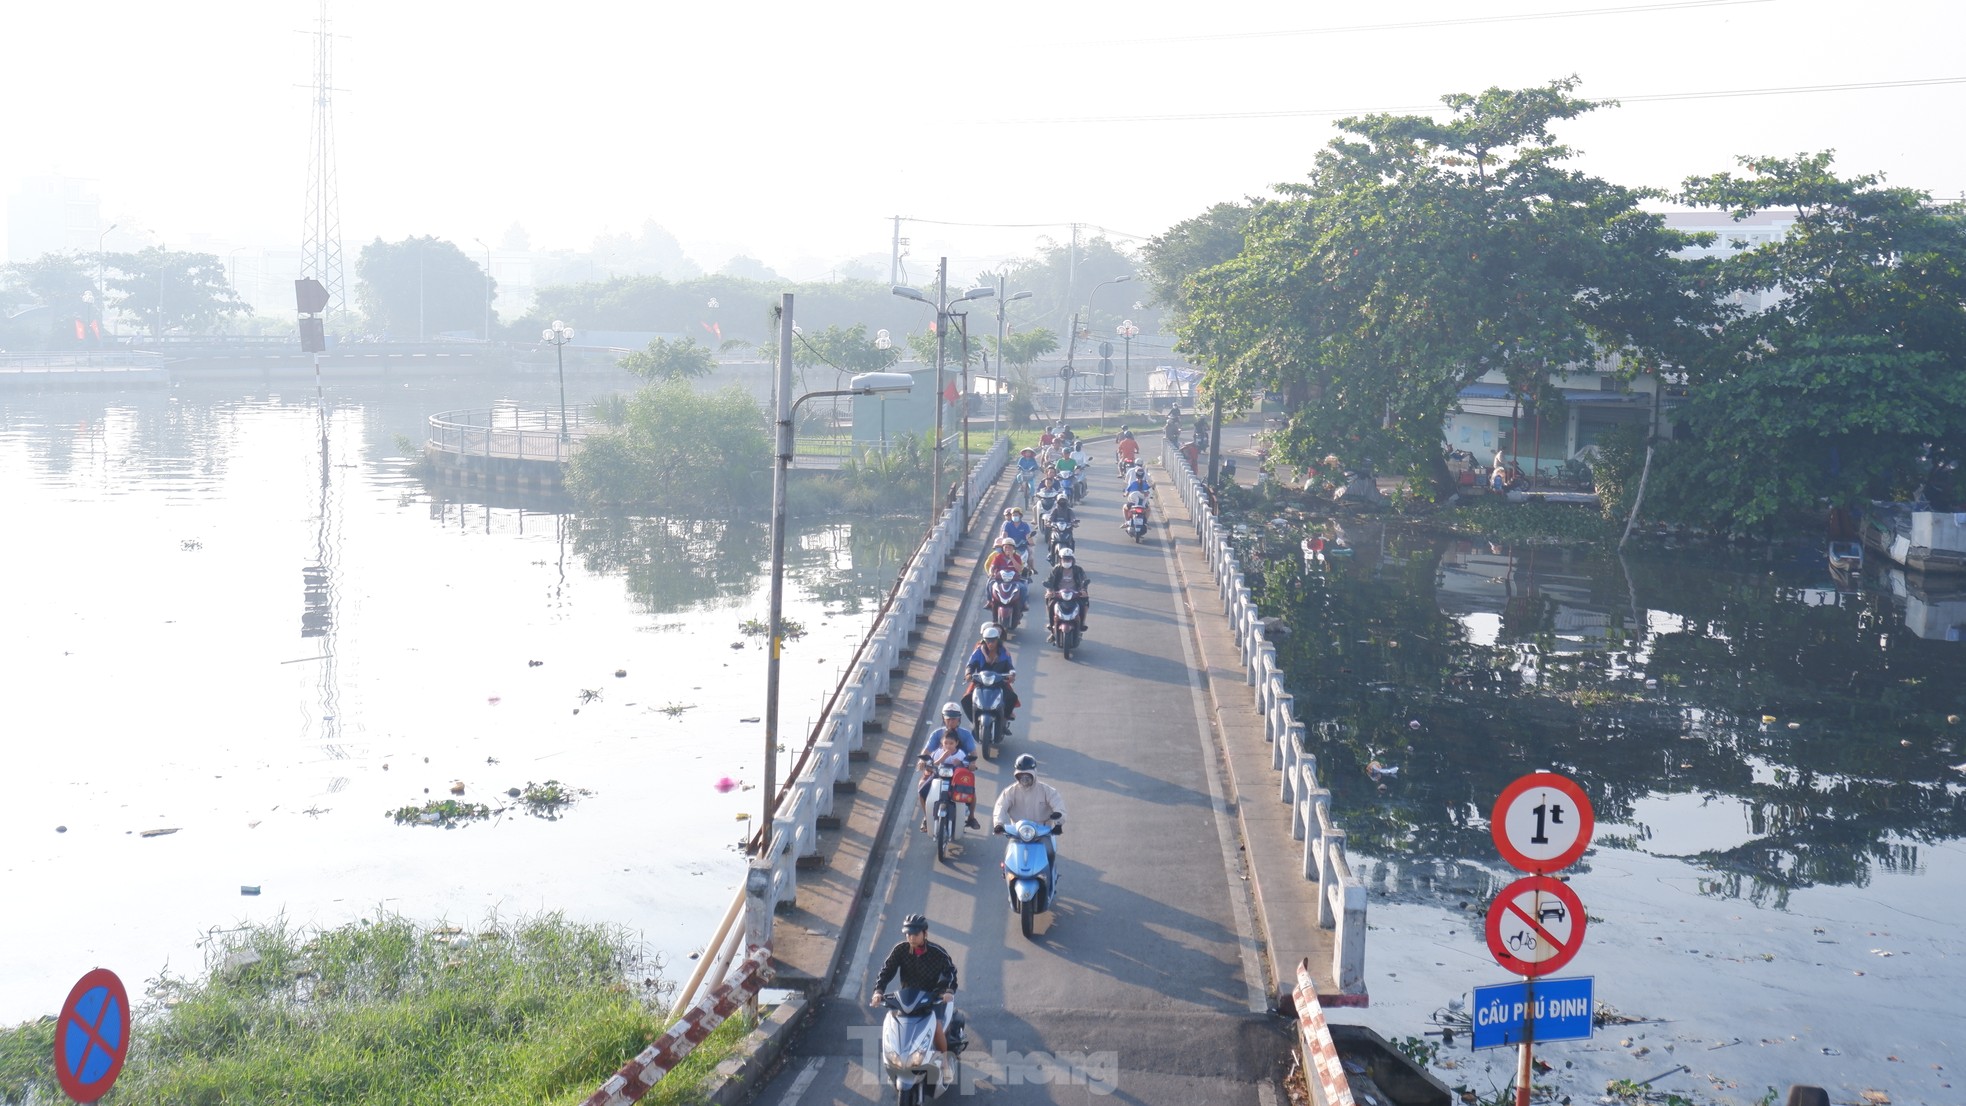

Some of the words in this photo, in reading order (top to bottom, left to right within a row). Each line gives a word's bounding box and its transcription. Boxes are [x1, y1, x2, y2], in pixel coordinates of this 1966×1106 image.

[1478, 998, 1508, 1026] CẦU
[1514, 995, 1543, 1021] PHÚ
[1548, 997, 1587, 1022] ĐỊNH
